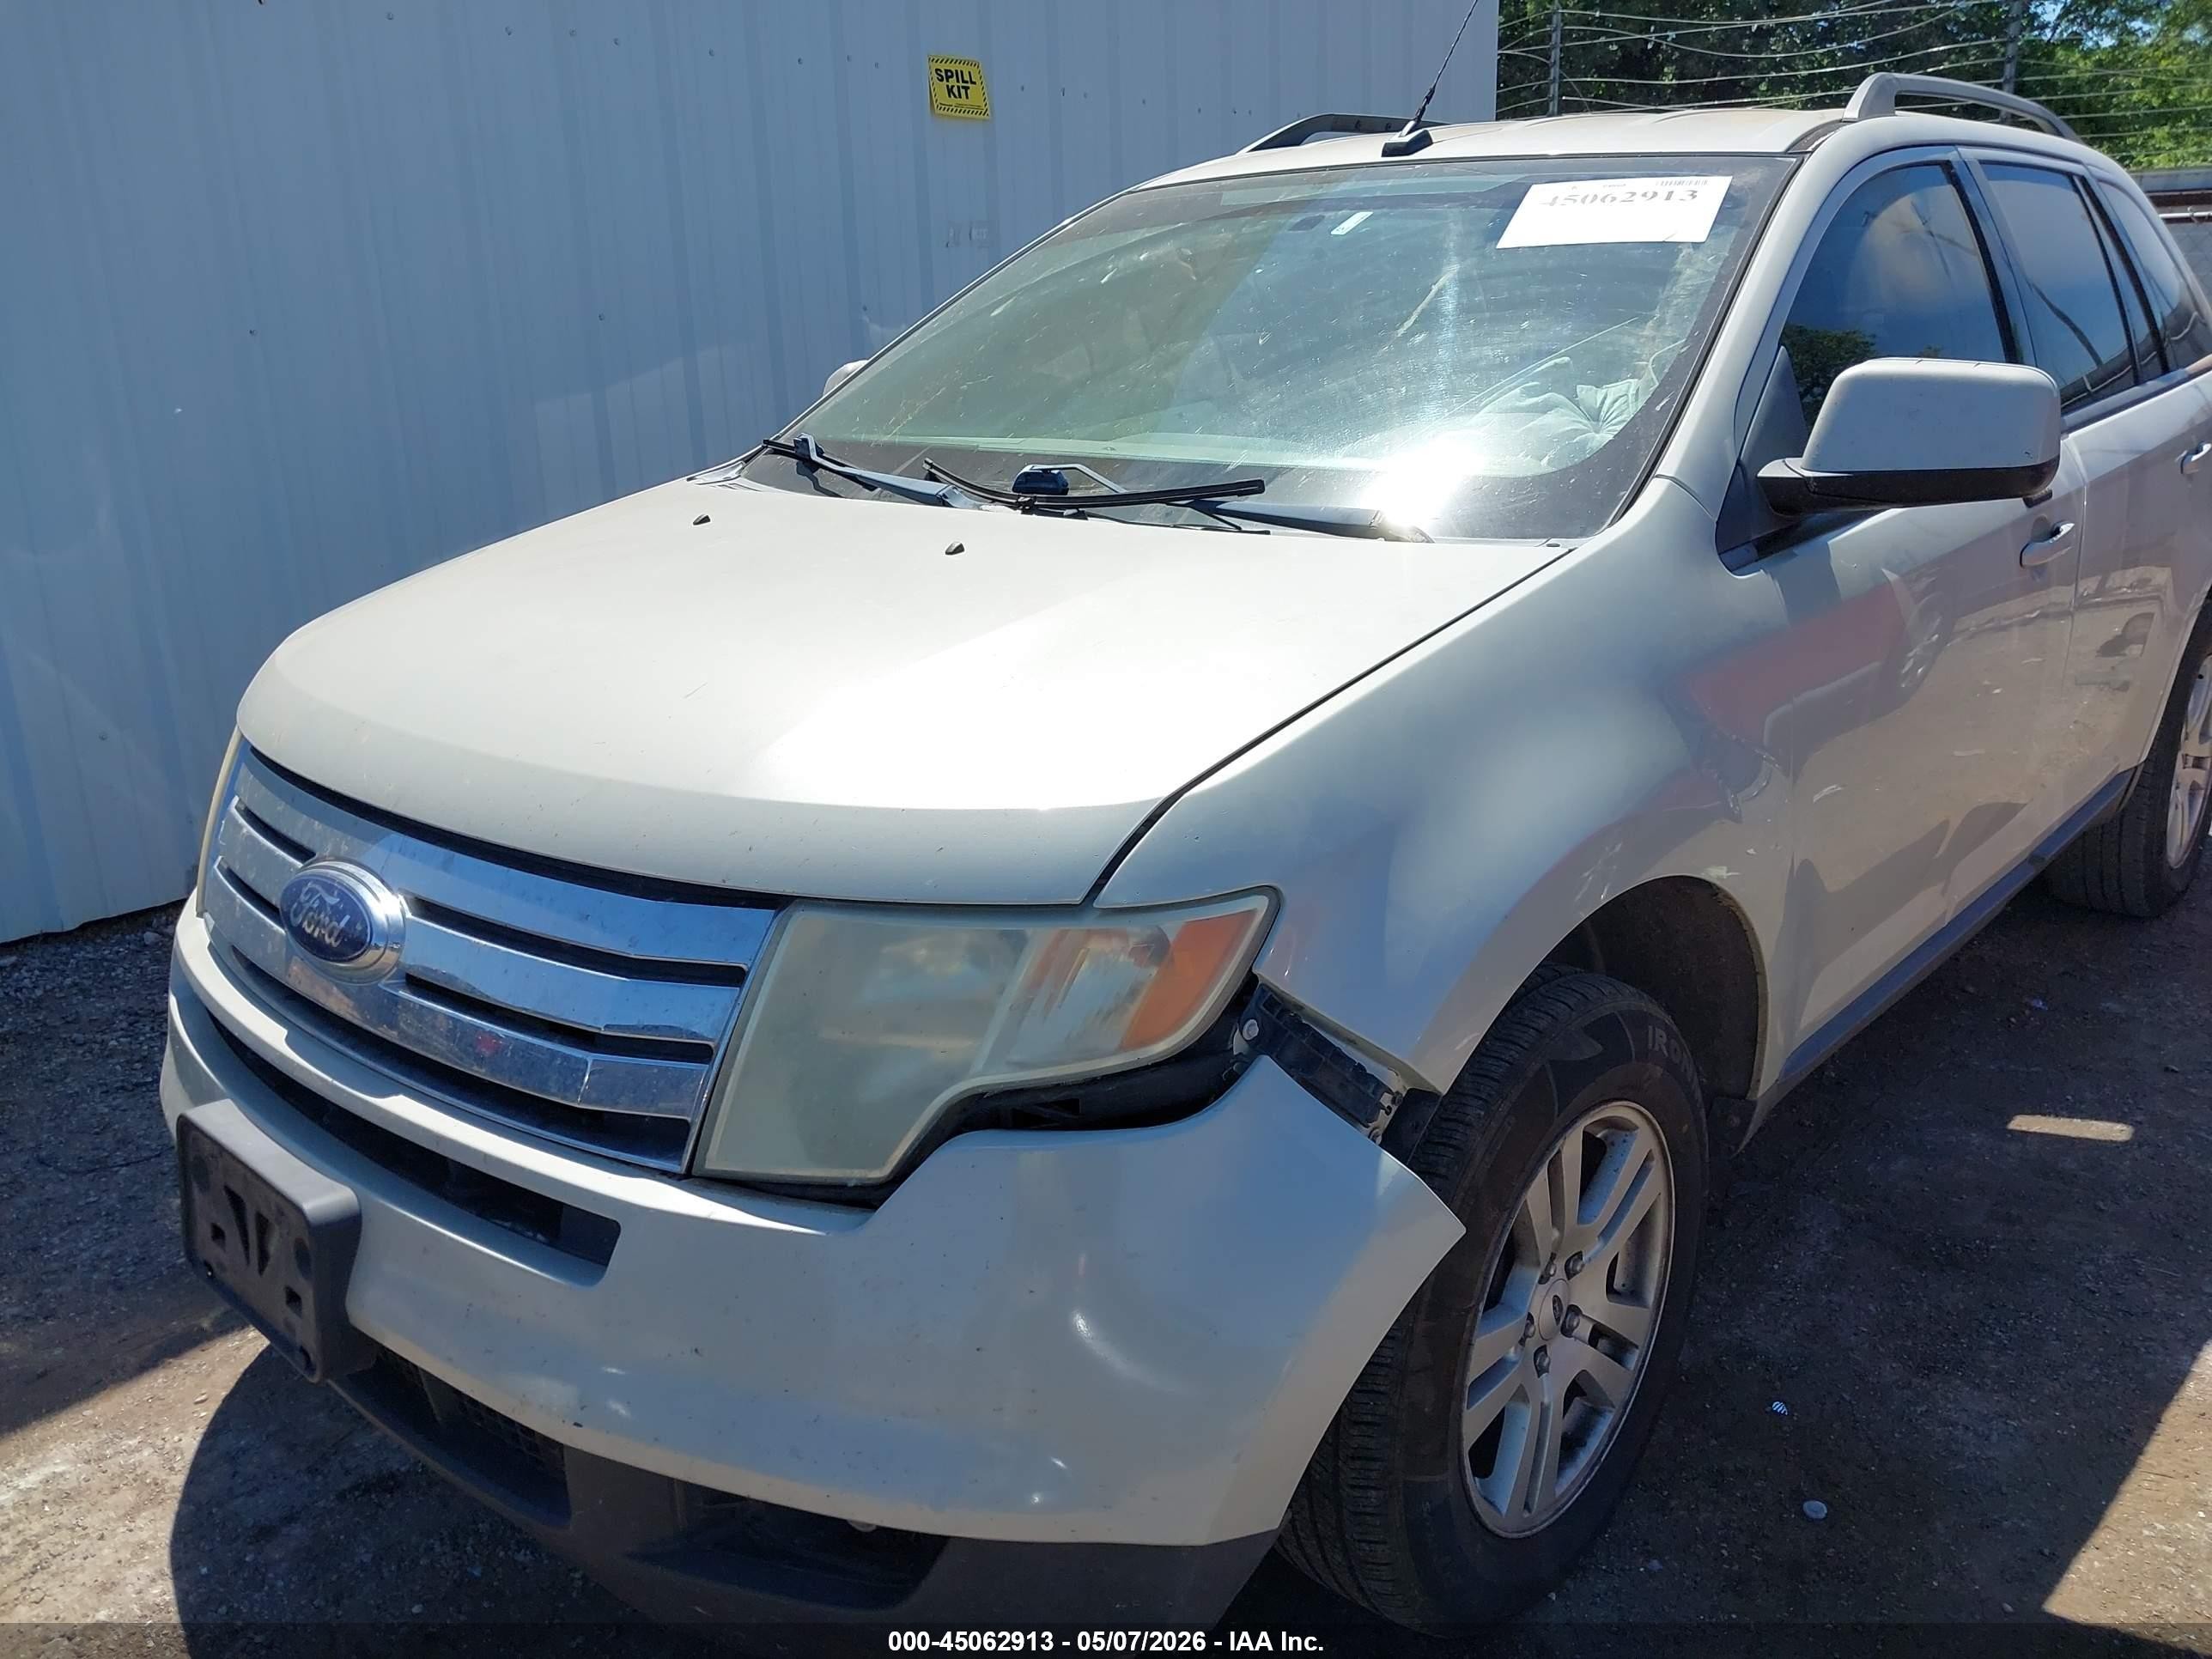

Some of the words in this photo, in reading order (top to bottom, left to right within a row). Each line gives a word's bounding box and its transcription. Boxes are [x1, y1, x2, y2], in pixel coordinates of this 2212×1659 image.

[934, 68, 977, 85] SPILL
[945, 84, 970, 100] KIT
[1541, 190, 1698, 206] 45062913
[290, 880, 351, 948] Ford
